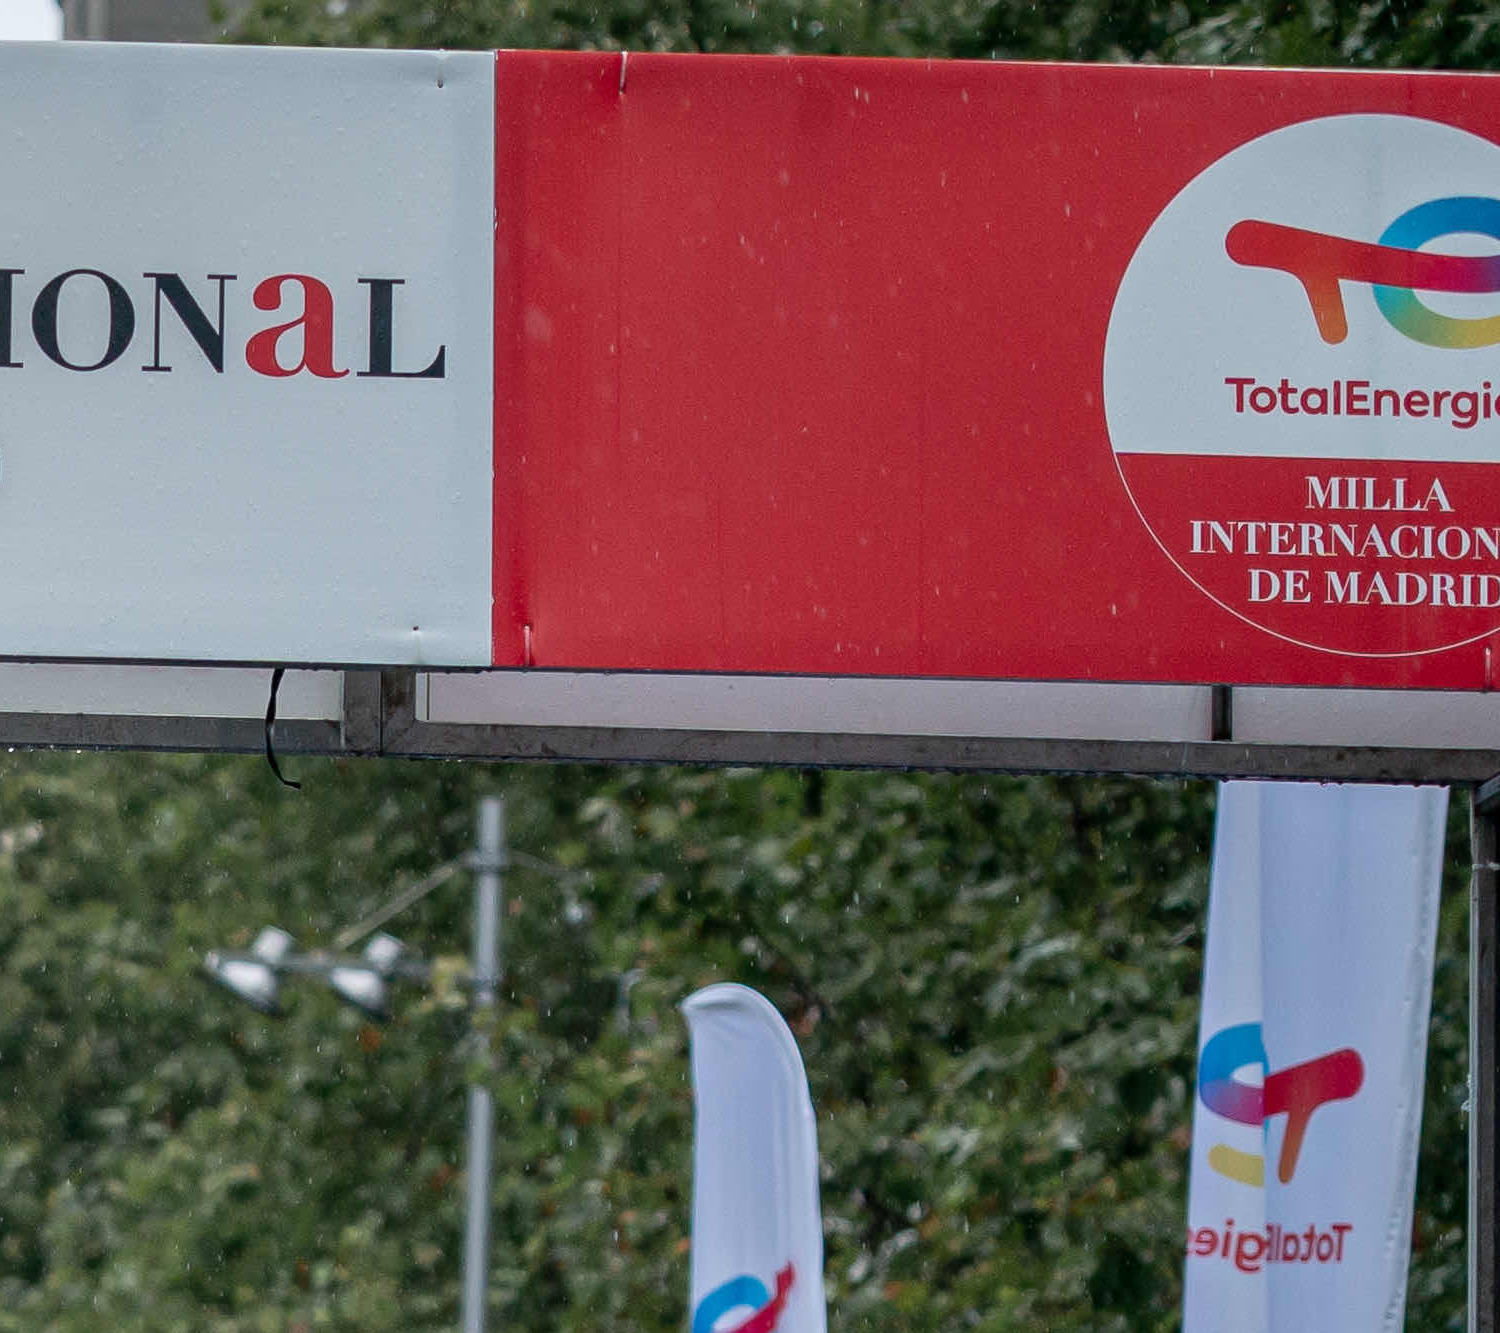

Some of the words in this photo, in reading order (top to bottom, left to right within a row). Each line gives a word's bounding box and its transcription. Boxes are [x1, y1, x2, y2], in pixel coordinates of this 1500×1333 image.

[1224, 377, 1500, 430] TotalEnergi
[1305, 475, 1454, 513] MILLA
[1189, 520, 1500, 561] INTERNACION
[1247, 568, 1311, 604] DE
[1324, 571, 1500, 609] MADRID
